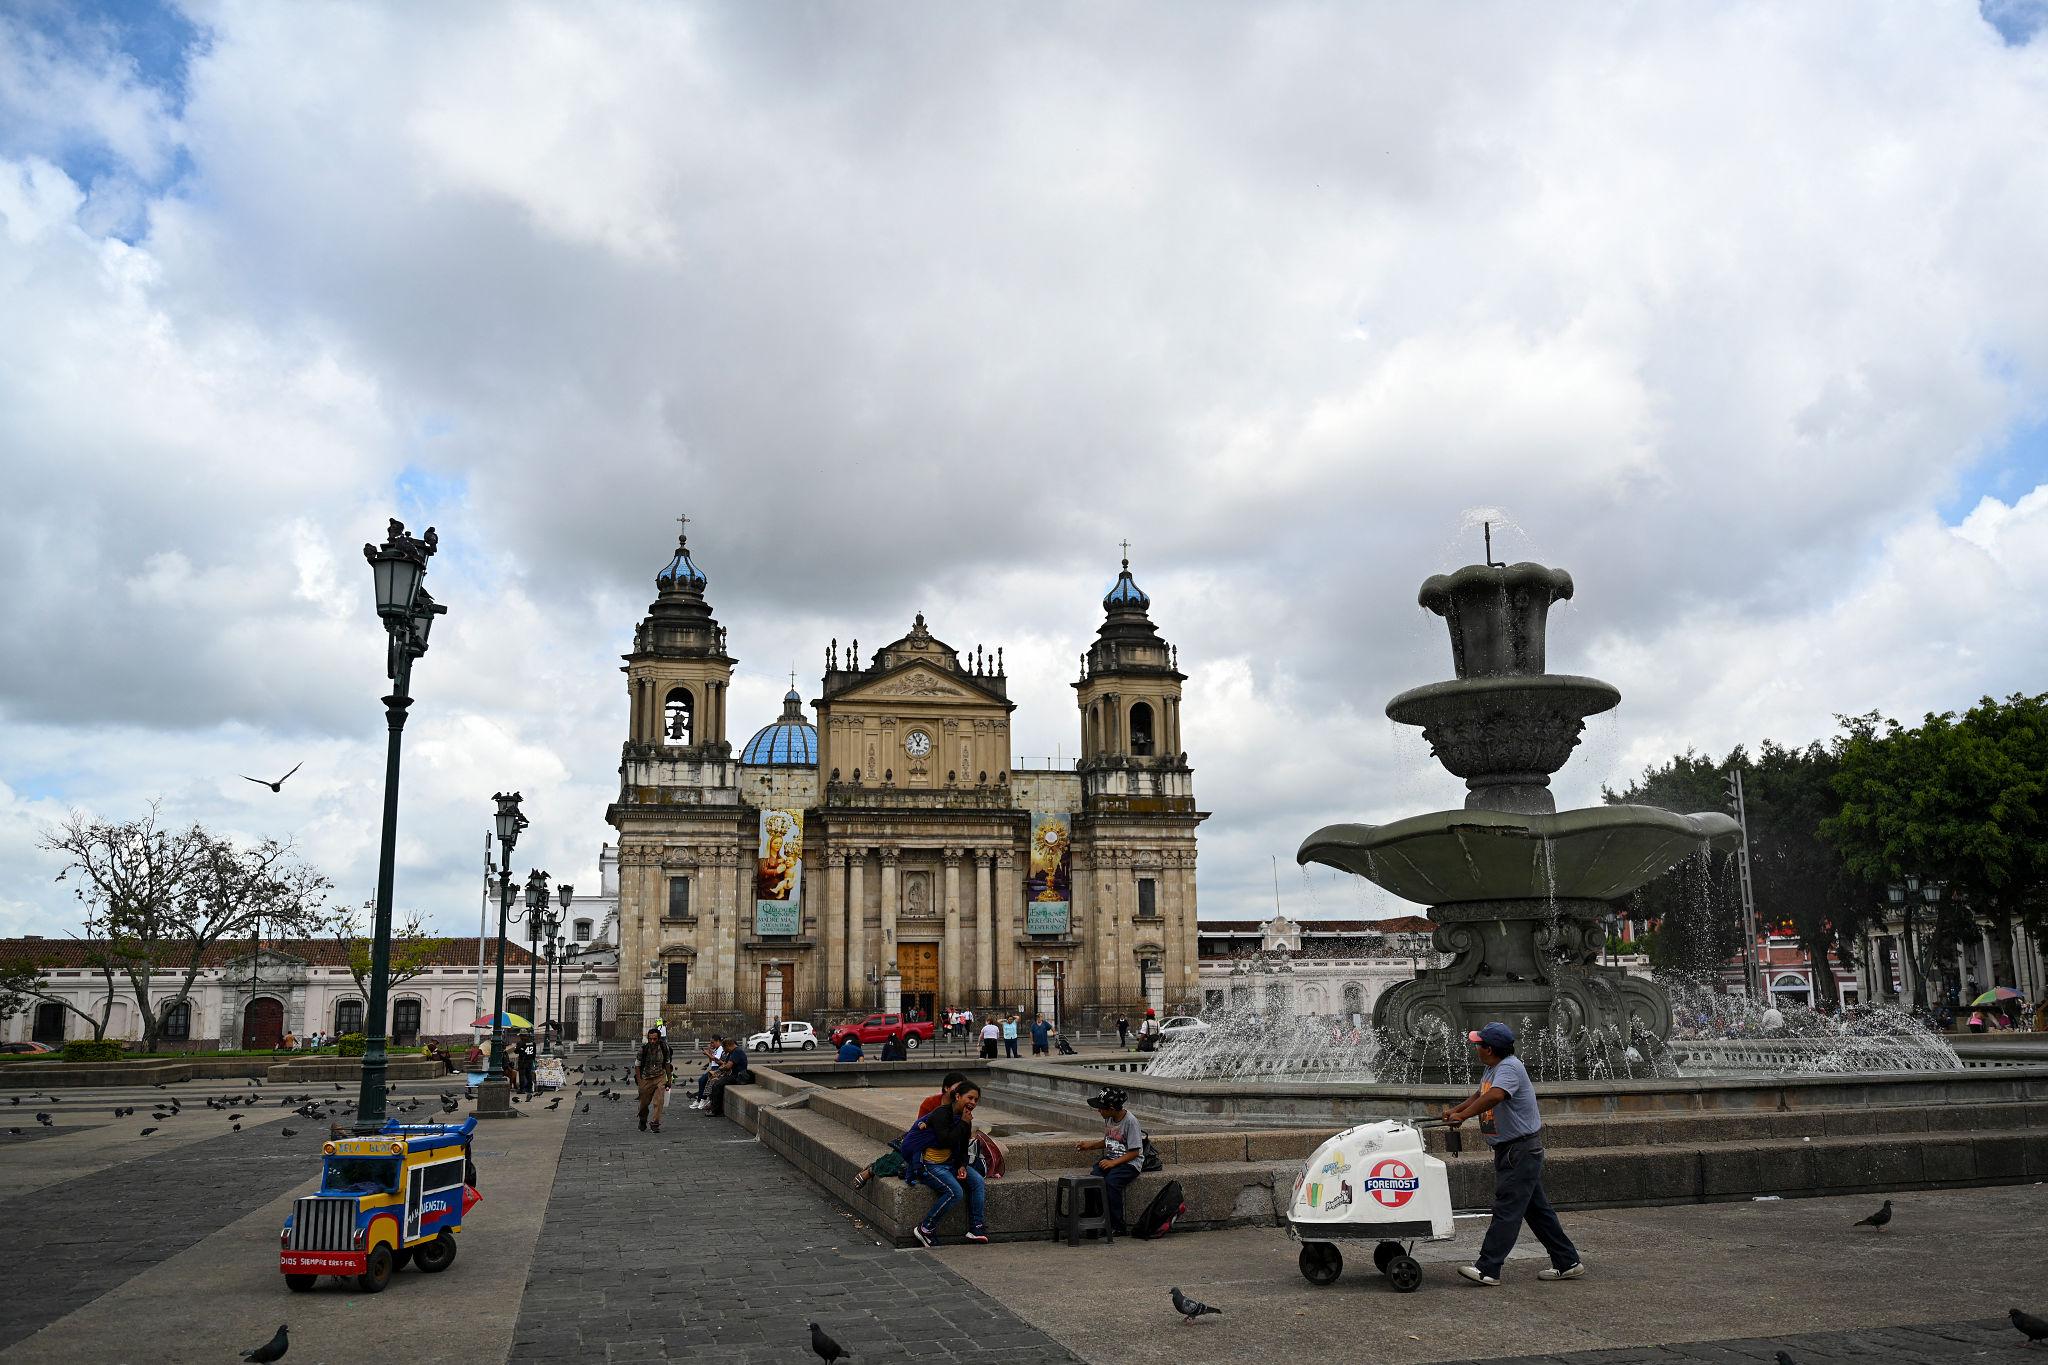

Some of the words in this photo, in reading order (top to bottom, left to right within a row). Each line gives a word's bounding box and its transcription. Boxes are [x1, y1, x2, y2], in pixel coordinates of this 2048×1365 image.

[525, 1046, 534, 1055] 42
[1367, 1179, 1416, 1189] FOREMOST
[280, 1256, 297, 1266] DIOS
[300, 1257, 328, 1266] SIEMPRE
